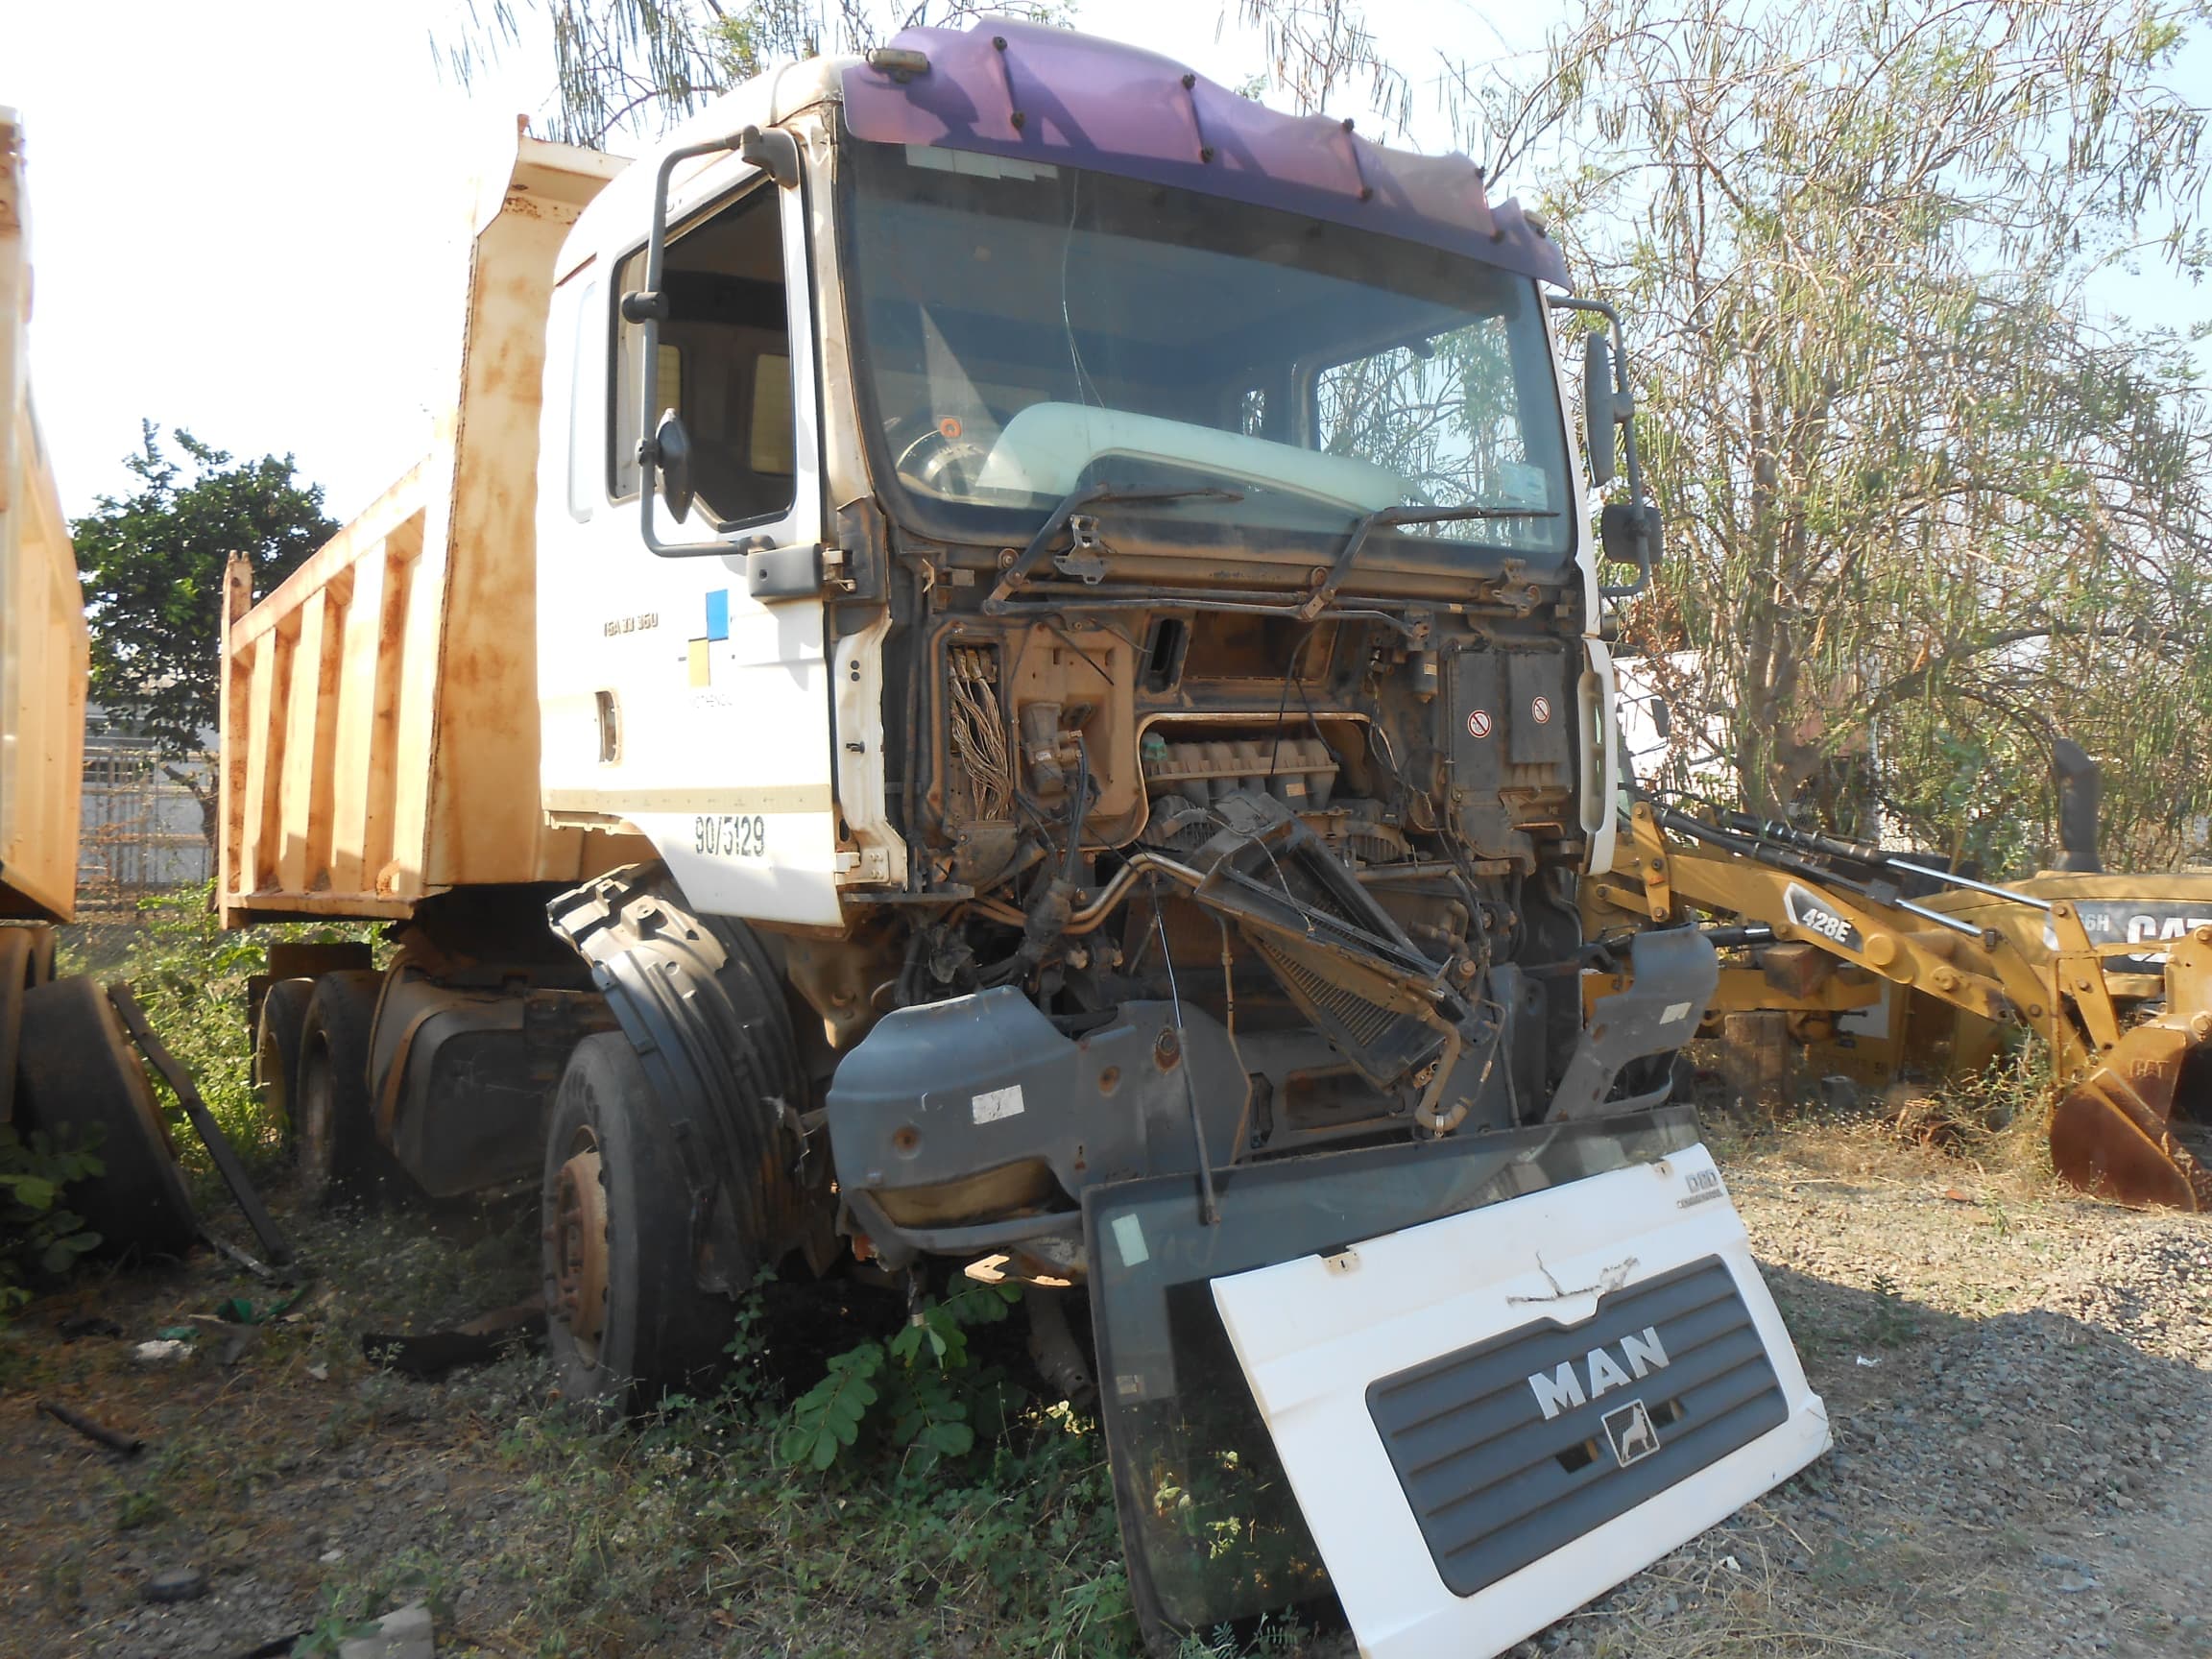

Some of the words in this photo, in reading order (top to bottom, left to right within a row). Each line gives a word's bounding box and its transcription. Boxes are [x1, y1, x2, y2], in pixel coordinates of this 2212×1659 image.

[696, 815, 764, 857] 90/5129
[1802, 908, 1852, 943] 428E
[2080, 912, 2109, 932] 6H
[1527, 1326, 1671, 1421] MAN
